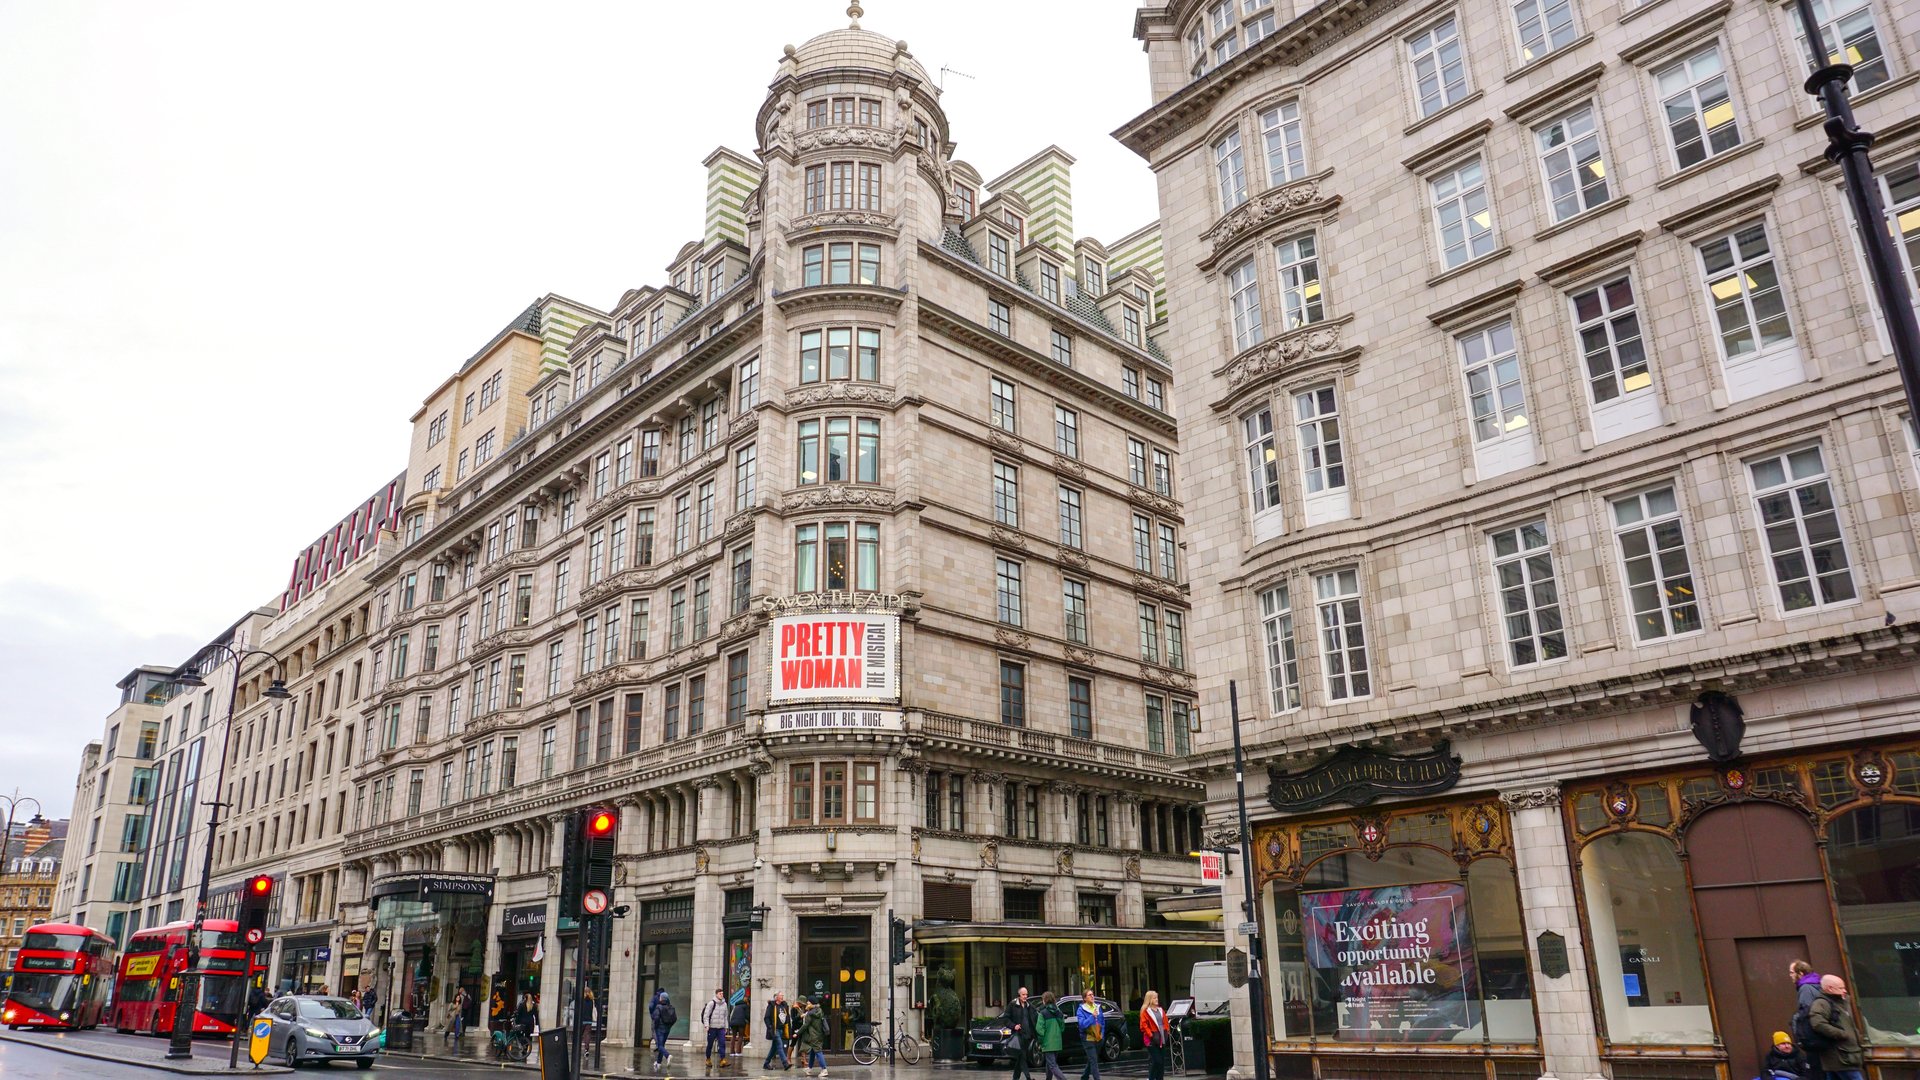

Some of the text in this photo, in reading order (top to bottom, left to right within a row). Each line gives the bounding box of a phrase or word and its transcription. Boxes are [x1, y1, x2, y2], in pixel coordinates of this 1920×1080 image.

[762, 589, 913, 611] SAVOY THEATRE
[781, 622, 866, 658] PRETTY
[867, 622, 886, 688] THE MUSICAL
[781, 658, 863, 690] WOMAN
[780, 712, 884, 729] BIG NIGHT OUT. BIG. HUGE.
[1279, 761, 1446, 802] SAVOY TAYLORS GUILD
[1202, 855, 1219, 868] PRETTY
[433, 881, 485, 891] SIMPSON'S
[1203, 869, 1219, 880] WOMAN
[1334, 917, 1429, 944] Exciting
[1337, 943, 1431, 966] opportunity
[1340, 961, 1436, 987] available
